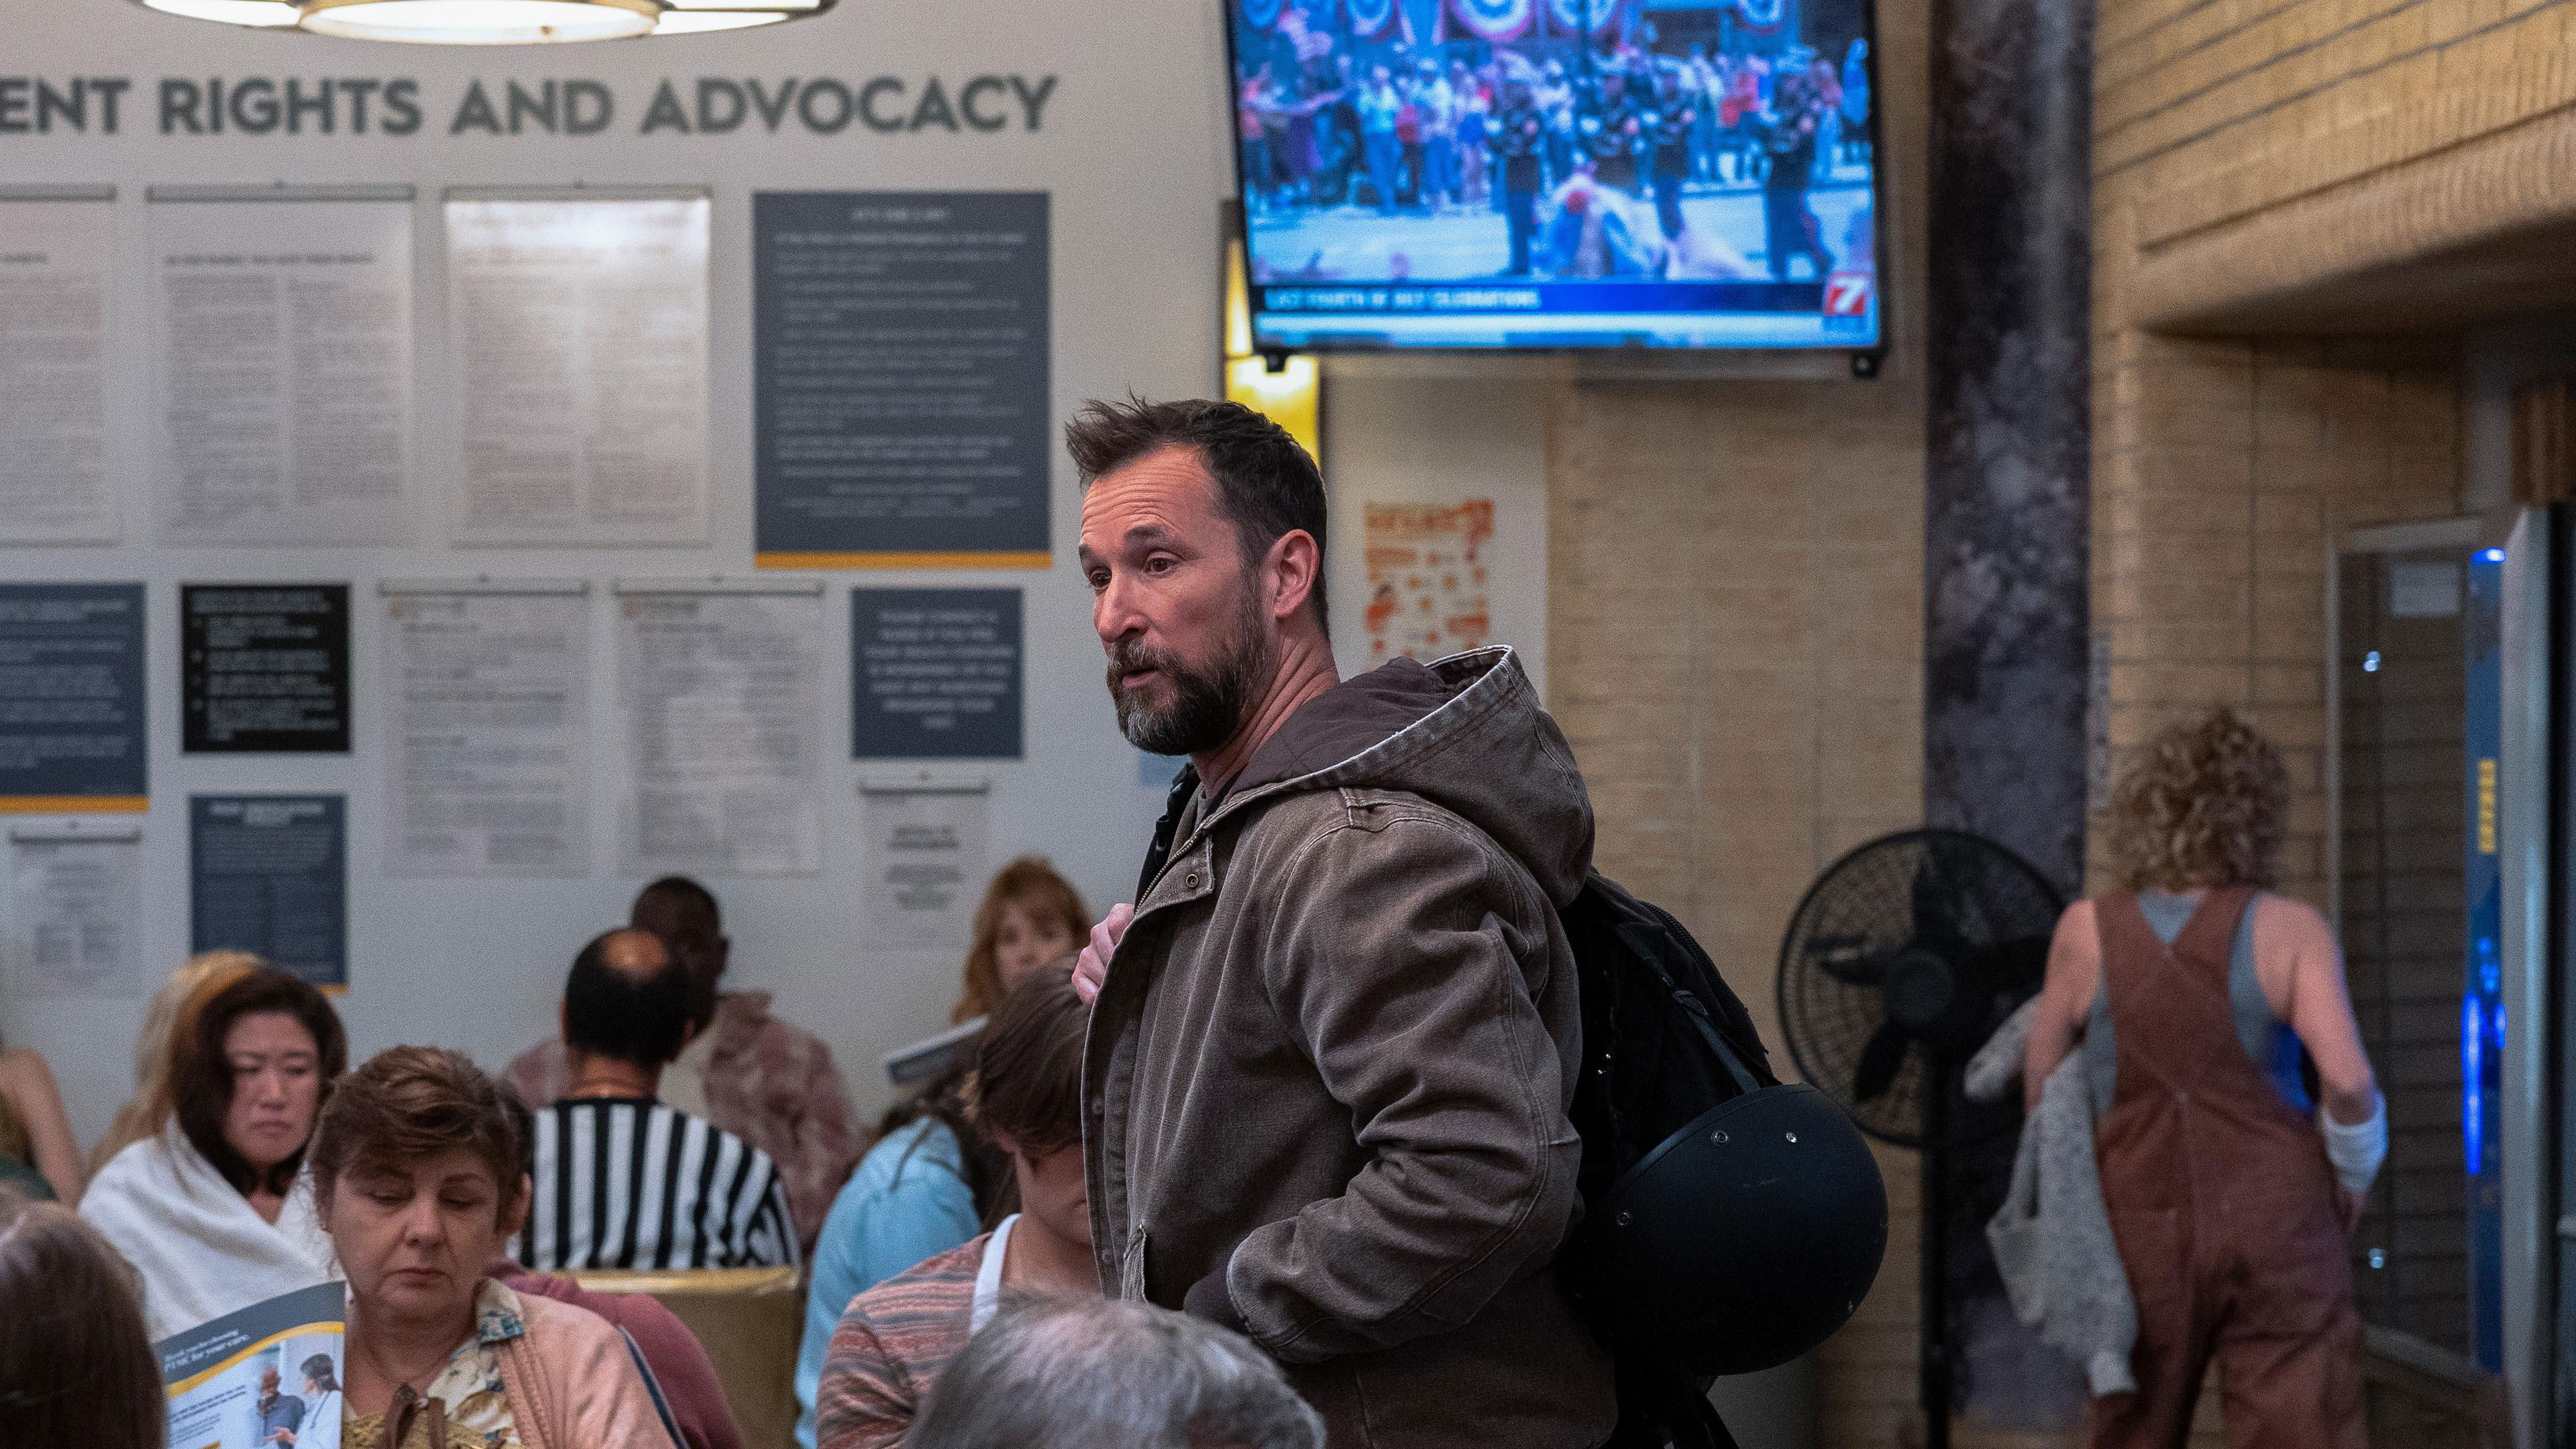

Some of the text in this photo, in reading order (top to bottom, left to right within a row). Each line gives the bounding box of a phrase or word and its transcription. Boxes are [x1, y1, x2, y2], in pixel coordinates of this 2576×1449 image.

[0, 74, 1058, 135] ENT RIGHTS AND ADVOCACY
